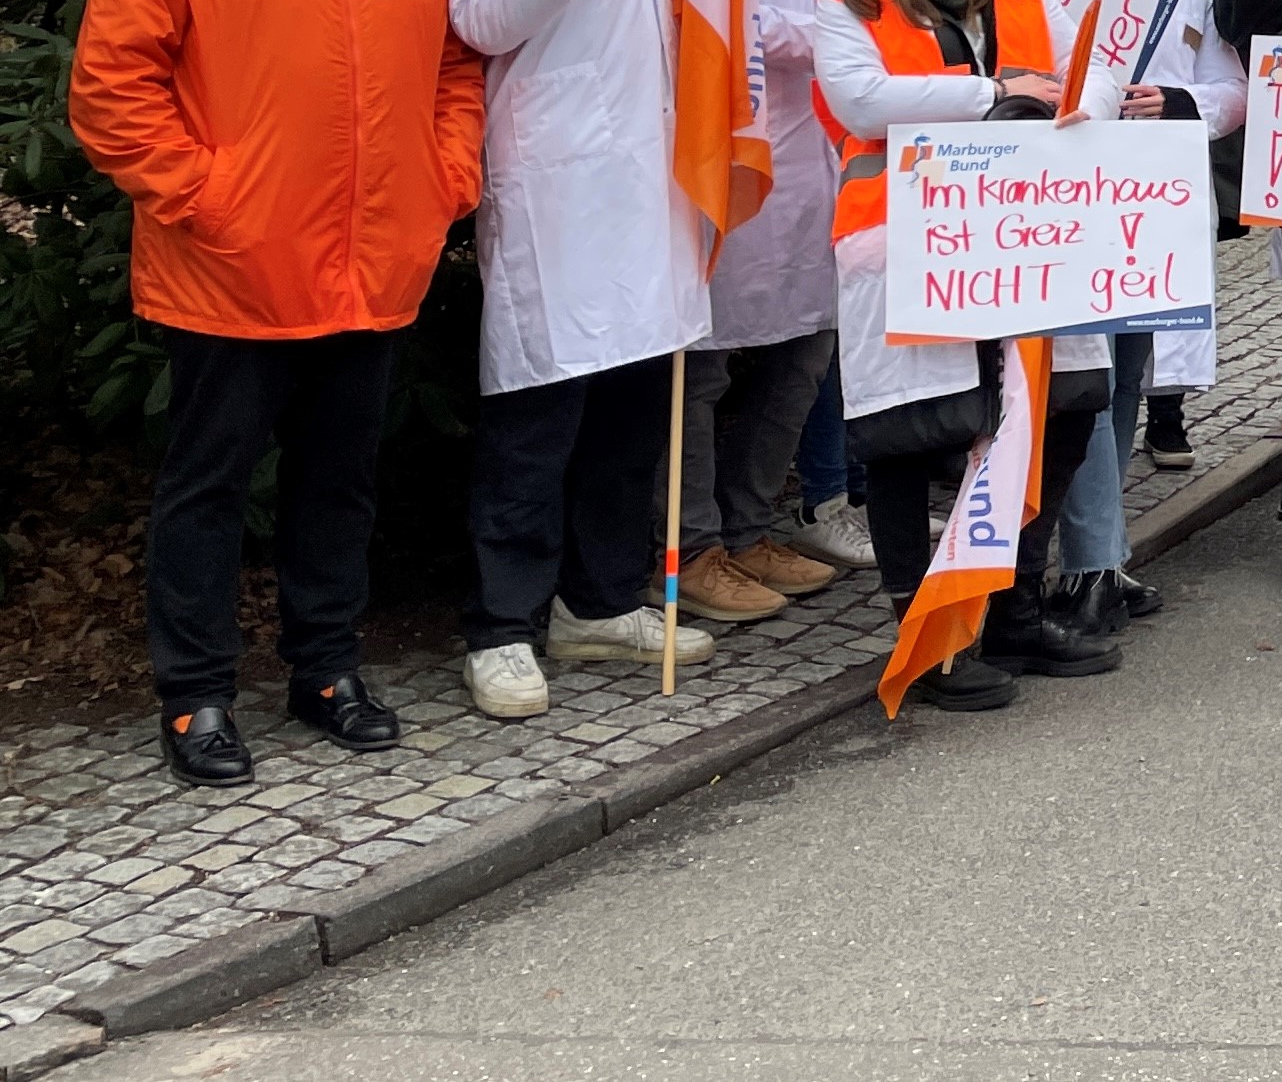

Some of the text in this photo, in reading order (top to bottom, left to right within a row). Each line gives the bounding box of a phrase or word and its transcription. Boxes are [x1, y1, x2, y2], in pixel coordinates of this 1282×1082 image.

[936, 142, 1020, 160] Marburger
[949, 158, 991, 173] Bund
[921, 165, 1193, 211] Im Krankenhaus
[924, 218, 975, 256] ist
[925, 252, 1182, 314] NICHT geil
